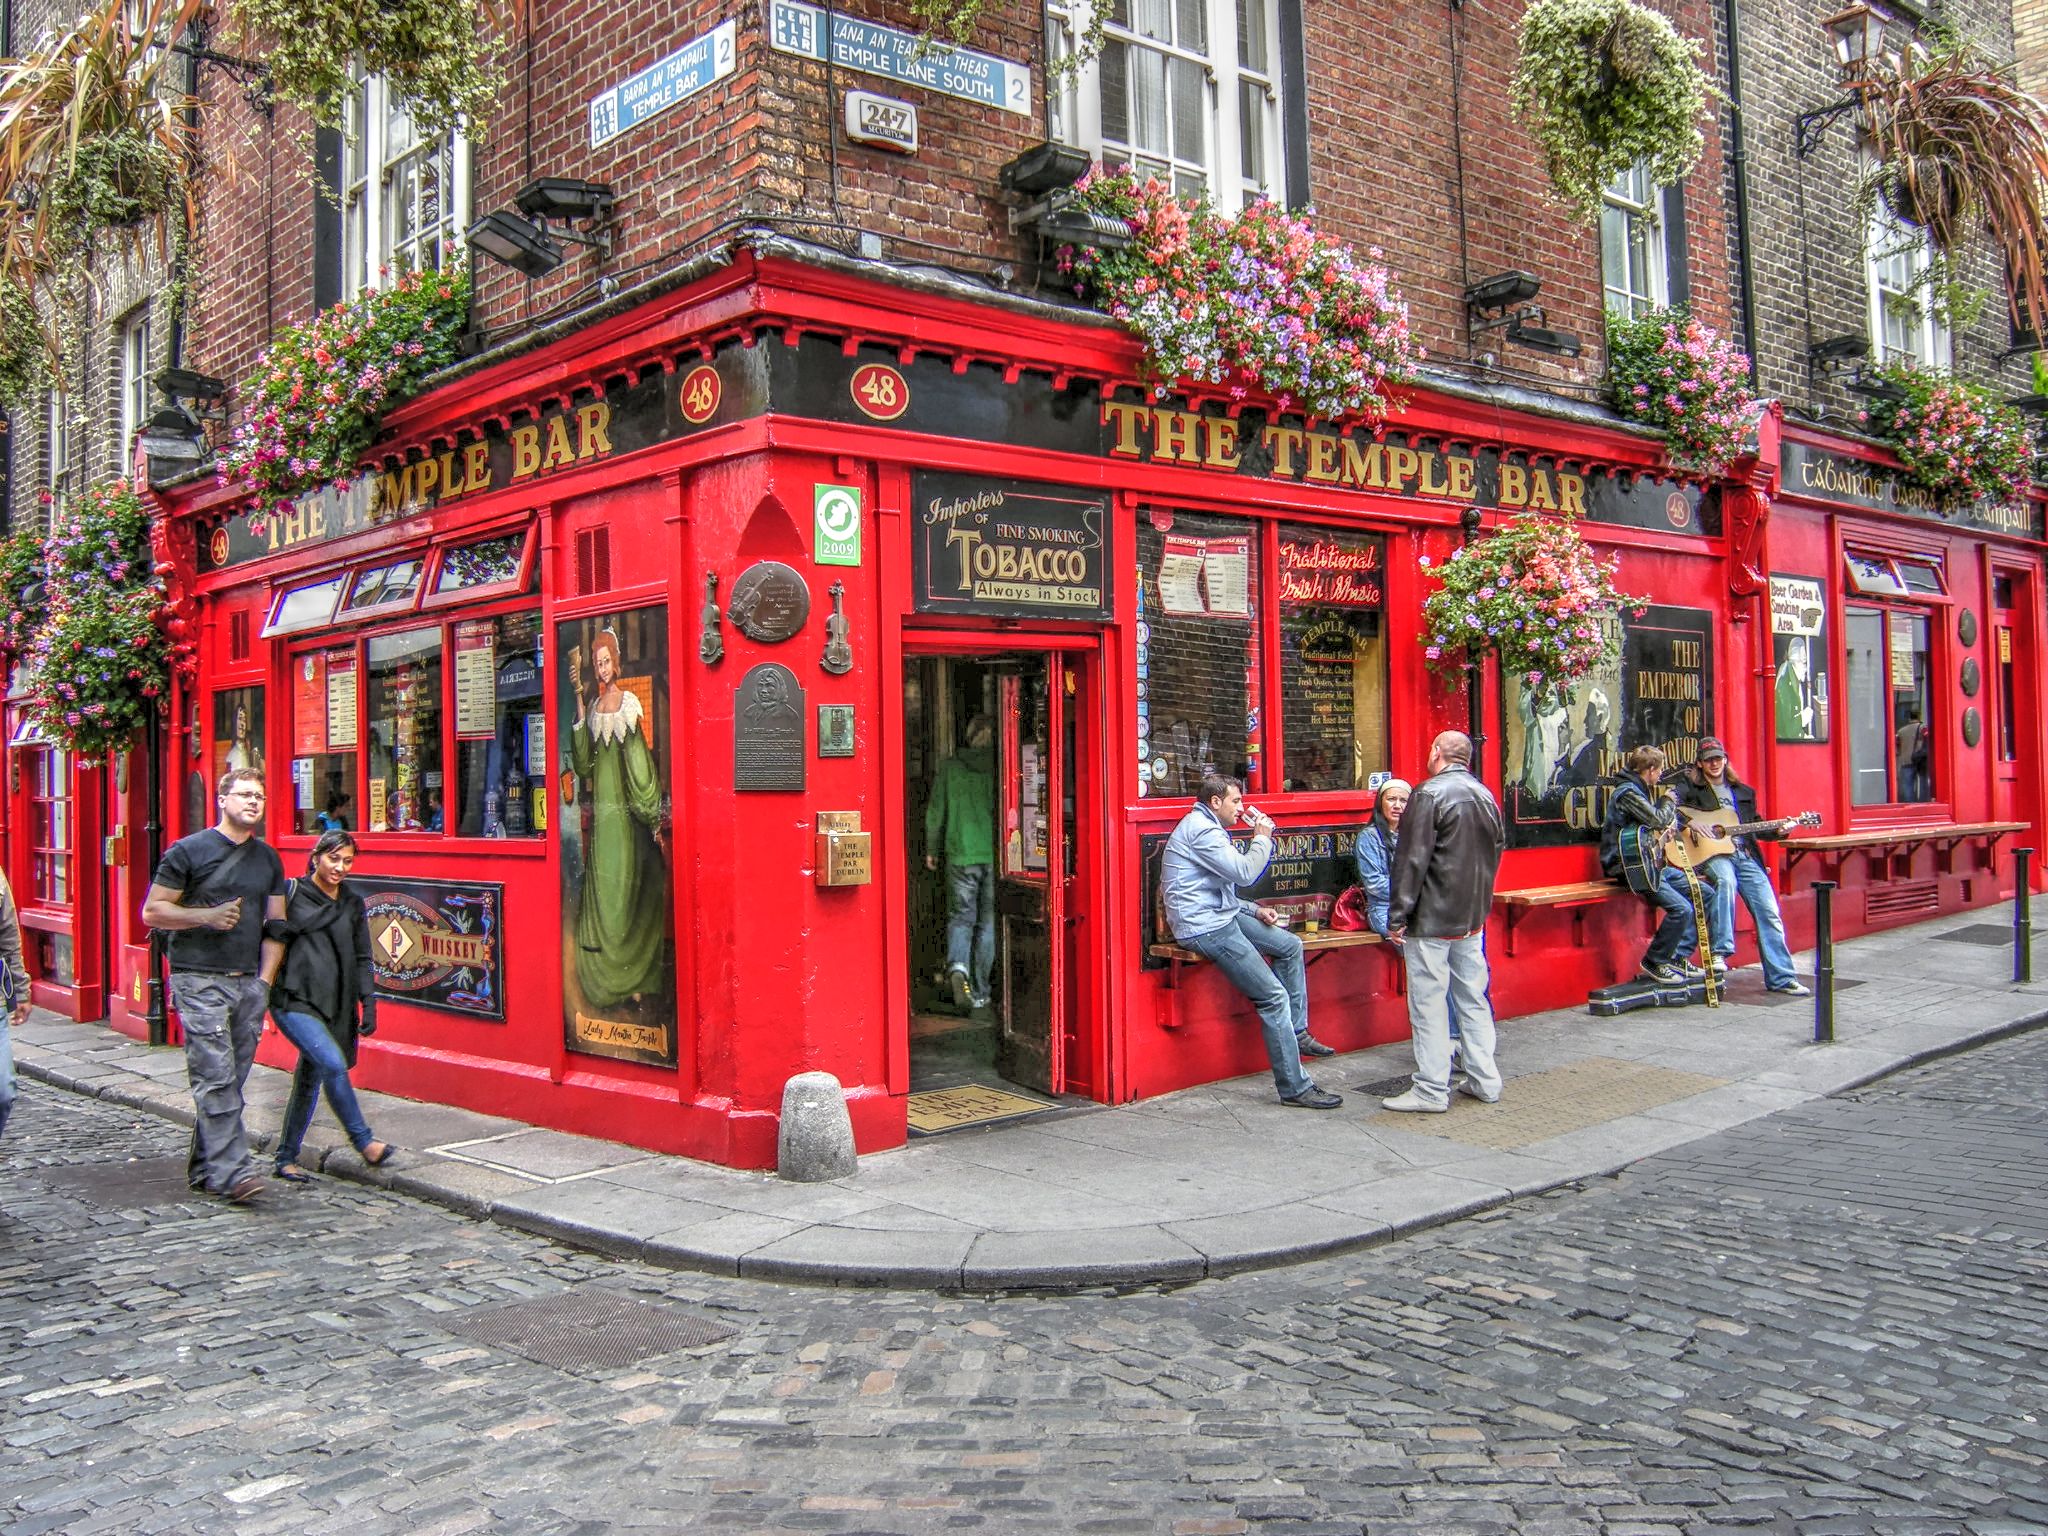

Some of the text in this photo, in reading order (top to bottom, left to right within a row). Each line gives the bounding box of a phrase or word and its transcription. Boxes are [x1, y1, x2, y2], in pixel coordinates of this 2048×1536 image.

[720, 38, 731, 64] 2
[833, 22, 864, 44] LÁNA
[869, 31, 888, 49] AN
[954, 55, 989, 79] THEAS
[623, 43, 708, 106] BARRA AN TEAMPAILL
[832, 41, 994, 99] TEMPLE LANE SOUTH
[631, 70, 699, 120] TEMPLE BAR
[1012, 78, 1025, 101] 2
[687, 376, 713, 415] 48
[861, 371, 897, 410] 48
[1103, 401, 1588, 515] THE TEMPLE BAR
[264, 402, 614, 550] THE TEMPLE BAR
[923, 489, 1005, 528] Importers
[975, 513, 990, 525] OF
[1670, 496, 1684, 520] 48
[996, 523, 1086, 545] FINE SMOKING
[823, 542, 854, 555] 2009
[946, 527, 1087, 591] TOBACCO
[1279, 543, 1376, 570] Traditional
[977, 582, 1098, 604] Always in Stock
[1279, 572, 1323, 600] Irish
[1331, 575, 1380, 603] Music
[1771, 581, 1787, 598] Beer
[1788, 583, 1813, 601] Garden
[1771, 600, 1800, 618] Smoking
[1300, 620, 1368, 650] TEMPLE BAR
[1777, 616, 1794, 632] Area
[1672, 640, 1700, 668] THE
[1637, 671, 1700, 700] EMPEROR
[1684, 706, 1700, 734] OF
[1659, 736, 1698, 770] IQUOR
[837, 851, 864, 859] TEMPLE
[836, 868, 865, 876] DUBLIN
[1271, 862, 1313, 878] DUBLIN
[1275, 879, 1309, 891] EST. 1840
[422, 934, 477, 961] WHISKEY
[944, 1106, 1012, 1120] BAR
